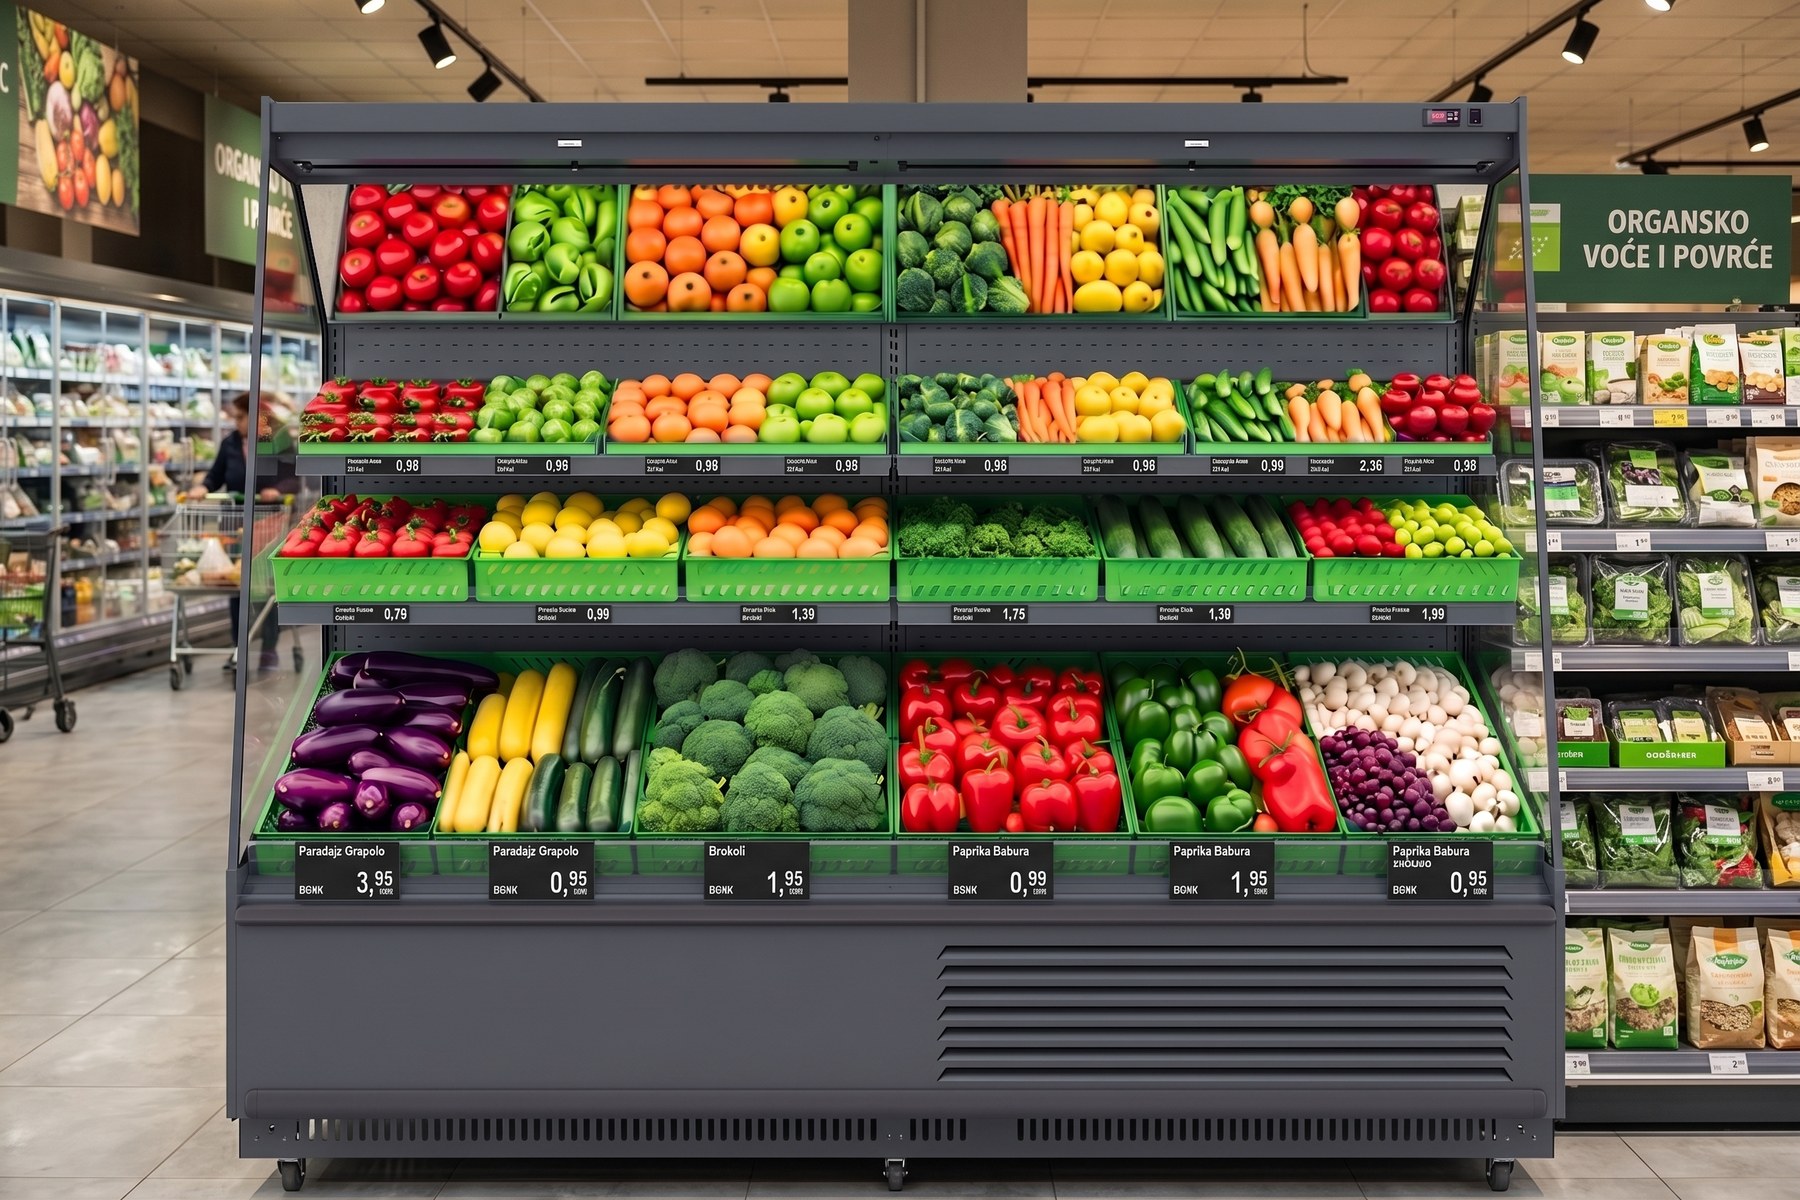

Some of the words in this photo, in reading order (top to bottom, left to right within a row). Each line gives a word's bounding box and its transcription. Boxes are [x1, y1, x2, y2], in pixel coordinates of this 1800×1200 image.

[1608, 209, 1749, 235] ORGANSKO
[1583, 237, 1650, 269] VOĆE
[1658, 244, 1665, 269] I
[1674, 237, 1773, 269] POVRĆE
[395, 459, 419, 473] 0,98
[984, 459, 1008, 473] 0,98
[1132, 459, 1156, 473] 0,98
[1261, 458, 1284, 473] 0,99
[1359, 459, 1383, 473] 2,36
[383, 607, 408, 622] 0,79
[586, 607, 610, 622] 0,99
[791, 607, 815, 622] 1,39
[1002, 607, 1026, 622] 1,75
[1421, 607, 1445, 622] 1,99
[299, 845, 342, 859] Paradajz
[345, 845, 385, 859] Grapolo
[494, 845, 536, 859] Paradajz
[539, 845, 579, 859] Grapolo
[709, 845, 746, 857] Brokoli
[953, 845, 991, 859] Paprika
[993, 845, 1030, 857] Babura
[1174, 845, 1212, 859] Paprika
[1214, 845, 1251, 857] Babura
[1393, 845, 1431, 859] Paprika
[1433, 845, 1470, 857] Babura
[357, 870, 394, 898] 3,95
[550, 870, 588, 898] 0,95
[767, 870, 804, 898] 1,95
[1010, 870, 1047, 898] 0,99
[1231, 870, 1268, 898] 1,95
[1450, 870, 1488, 898] 0,95
